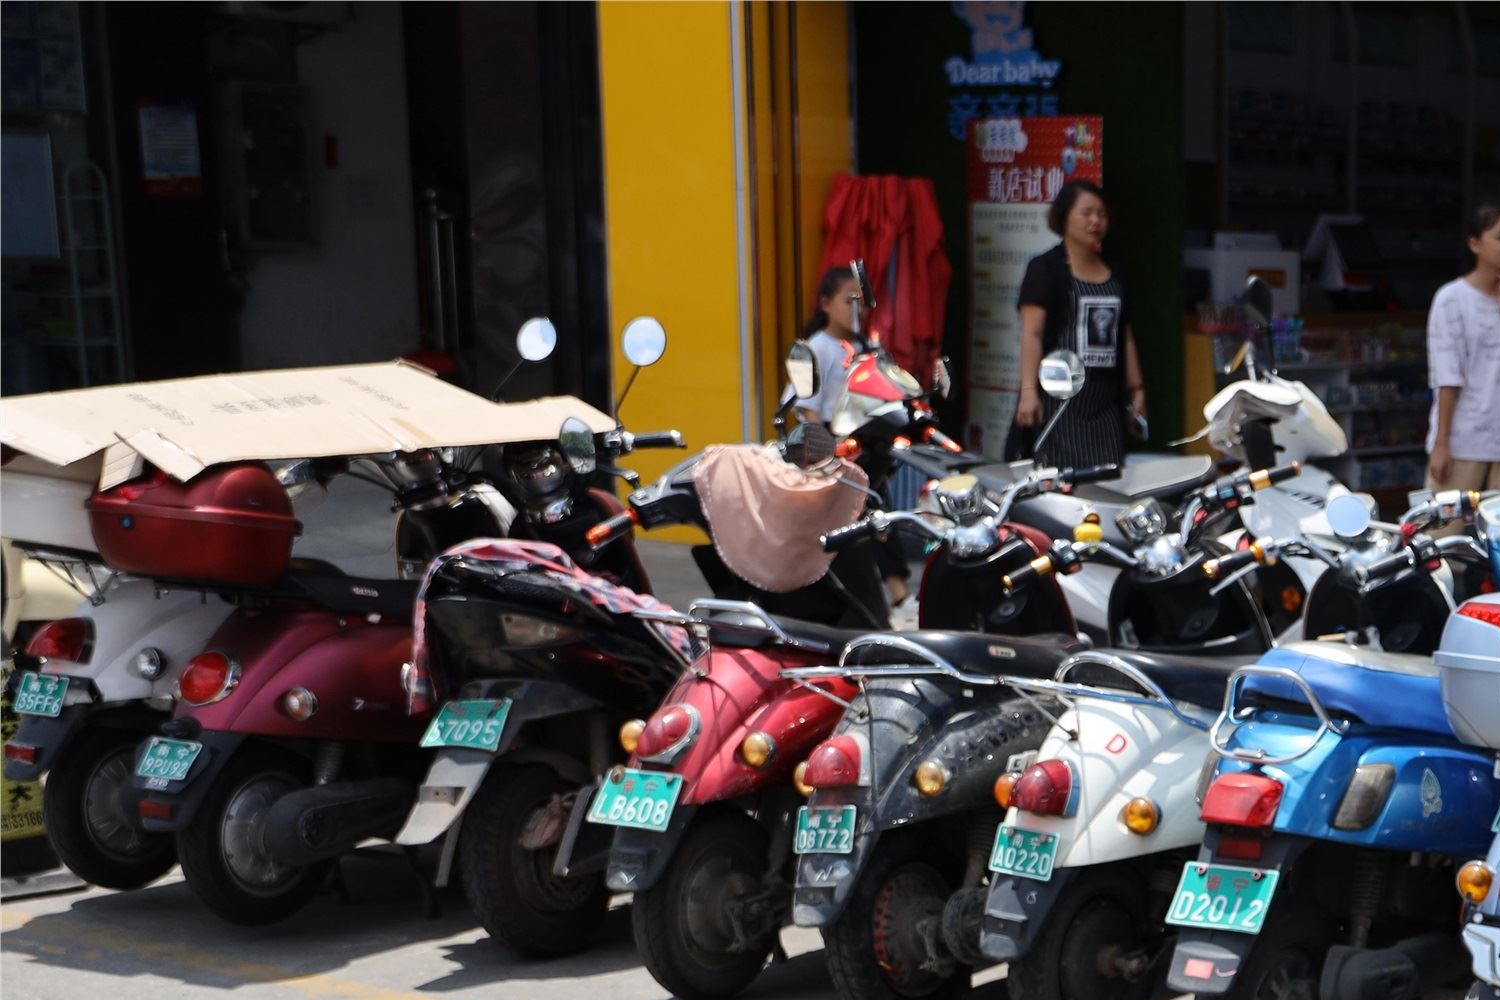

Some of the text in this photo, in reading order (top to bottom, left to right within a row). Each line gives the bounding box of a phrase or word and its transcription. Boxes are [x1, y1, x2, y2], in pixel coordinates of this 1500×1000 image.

[947, 58, 1000, 84] Dear
[17, 691, 61, 715] 35FF6
[993, 845, 1051, 875] A0220
[1172, 890, 1265, 928] D2012
